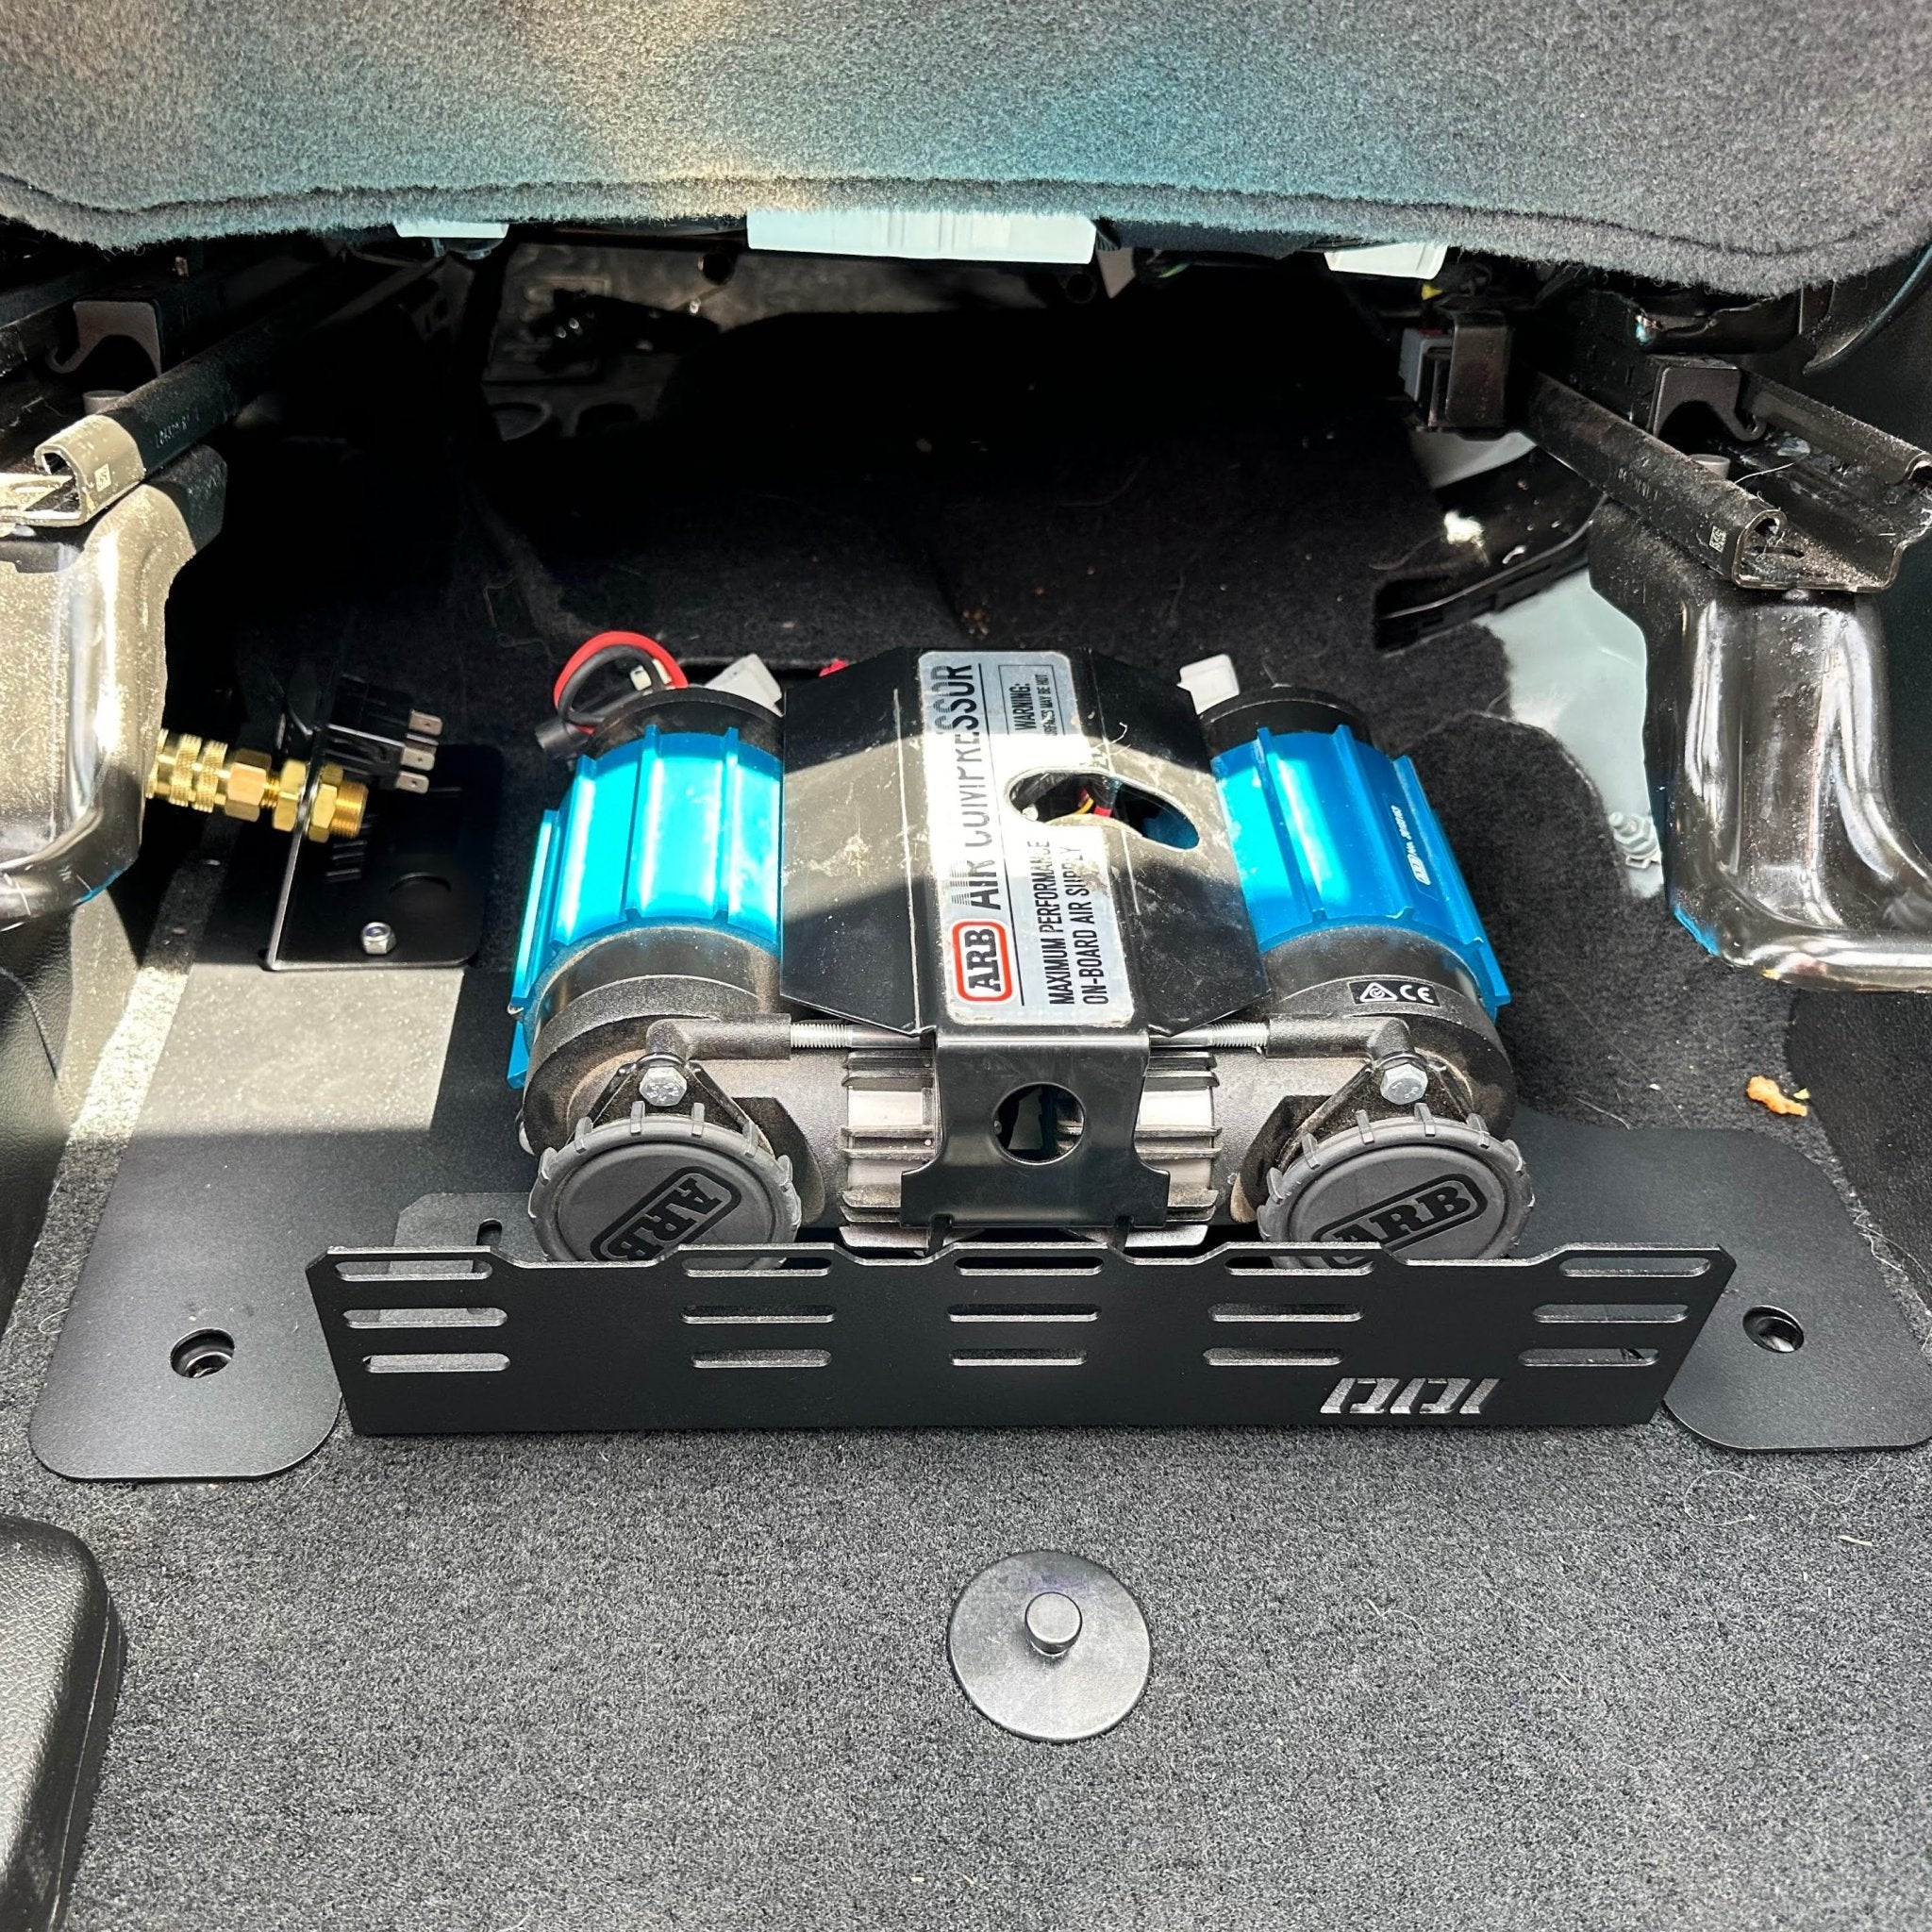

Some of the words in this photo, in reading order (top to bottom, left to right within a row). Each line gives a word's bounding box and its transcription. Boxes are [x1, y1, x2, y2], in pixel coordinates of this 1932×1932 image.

[1034, 674, 1049, 686] HOT
[1036, 686, 1051, 696] BE
[1039, 696, 1053, 709] MAY
[1008, 682, 1037, 731] WARNING:
[949, 859, 1001, 910] AIR
[1068, 901, 1095, 925] AIR
[964, 928, 1002, 992] ARB
[1041, 937, 1075, 1005] MAXIMUM
[1073, 929, 1109, 1005] ON-BOARD
[607, 1177, 724, 1261] ARB
